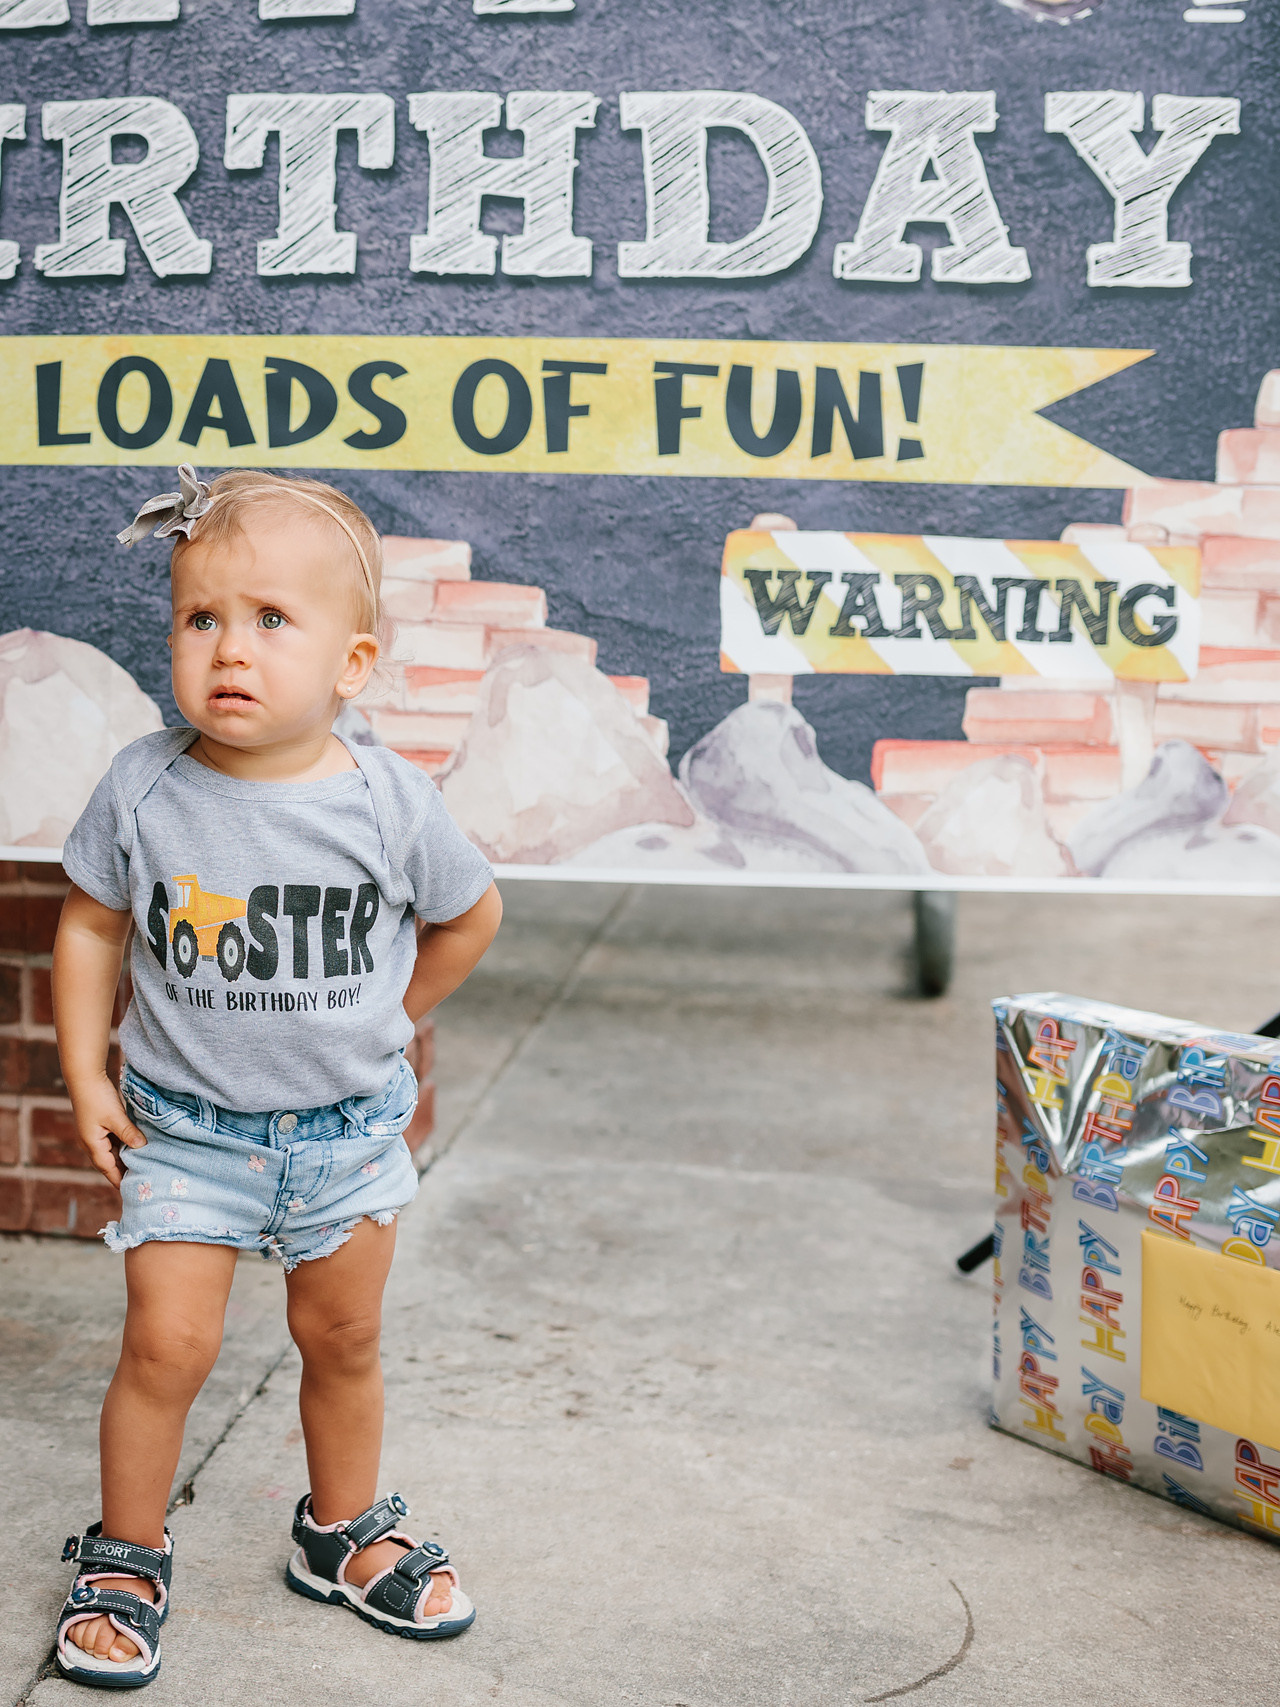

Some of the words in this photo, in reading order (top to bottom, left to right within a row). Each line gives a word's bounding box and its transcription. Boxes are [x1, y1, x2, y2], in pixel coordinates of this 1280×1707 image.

[35, 355, 409, 451] LOADS
[452, 357, 608, 455] OF
[653, 361, 925, 462] FUN!
[743, 569, 1179, 648] WARNING
[165, 981, 178, 1003] OF
[185, 985, 216, 1010] THE
[227, 990, 318, 1012] BIRTHDAY
[327, 982, 362, 1010] BOY!
[1146, 1125, 1210, 1248] APPY
[1079, 1218, 1126, 1363] HAPPY
[1019, 1305, 1067, 1443] HAPPY
[92, 1543, 132, 1559] SPORT
